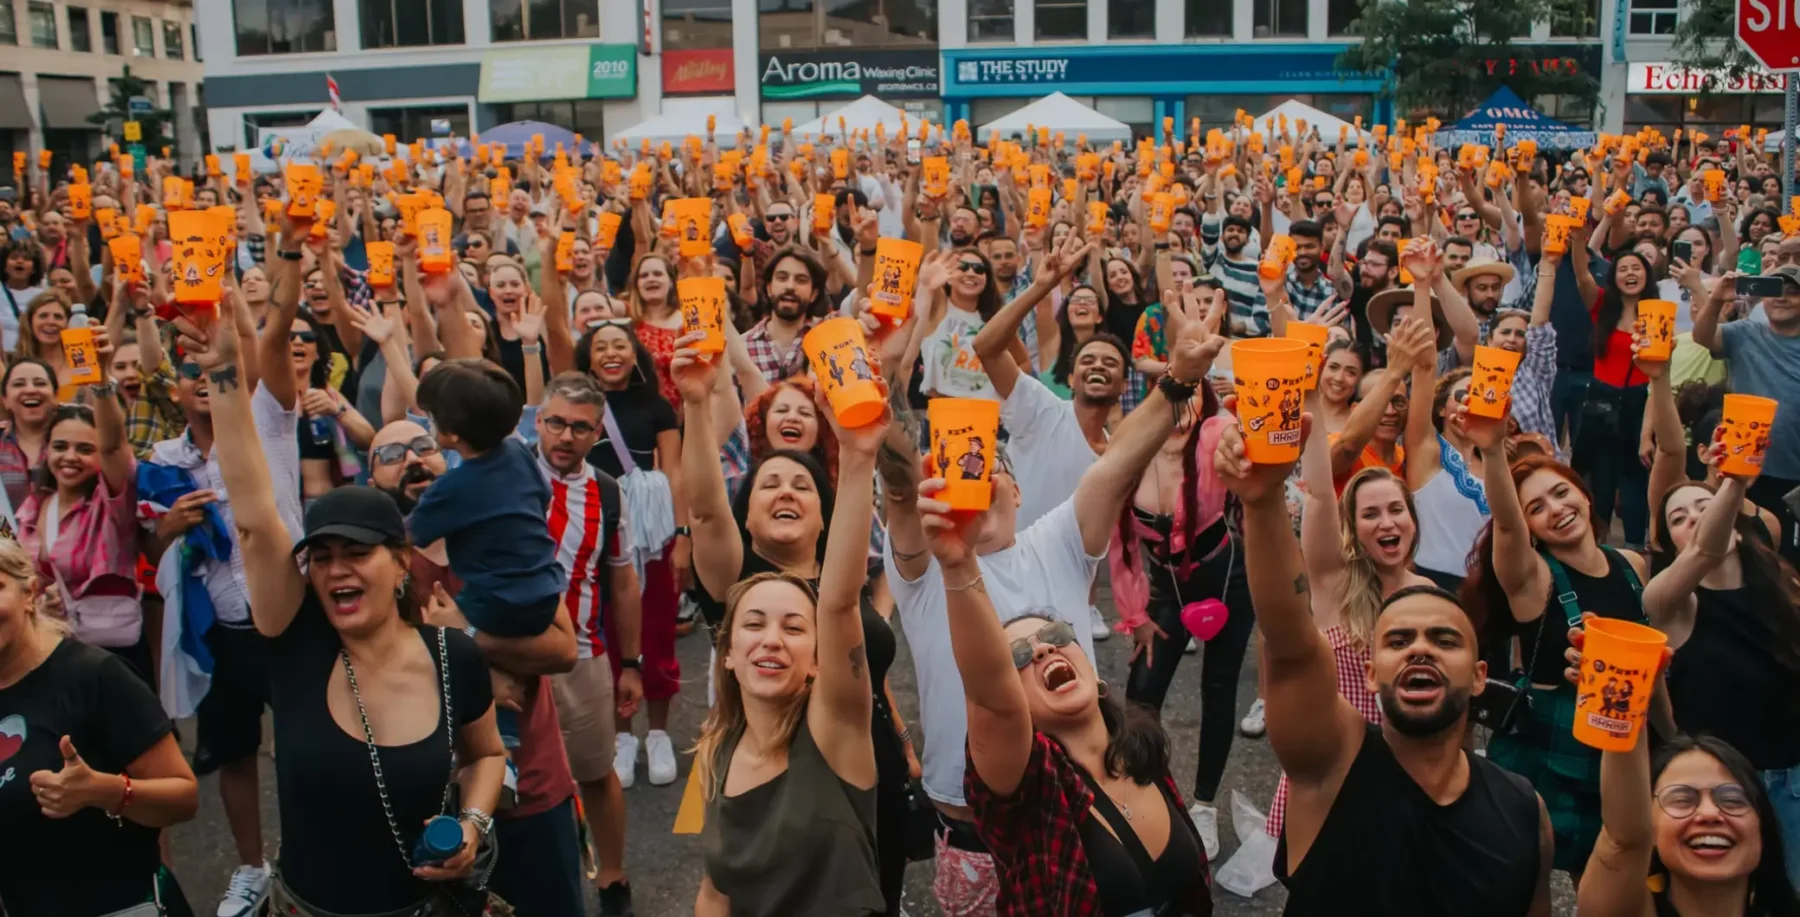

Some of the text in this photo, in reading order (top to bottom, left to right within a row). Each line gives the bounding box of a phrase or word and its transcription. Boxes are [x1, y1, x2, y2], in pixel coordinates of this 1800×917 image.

[1747, 0, 1800, 32] ST
[594, 60, 628, 73] 2010
[762, 56, 937, 82] Aroma Waxing Clinic
[980, 59, 1069, 74] THE STUDY
[1486, 107, 1539, 120] OMG
